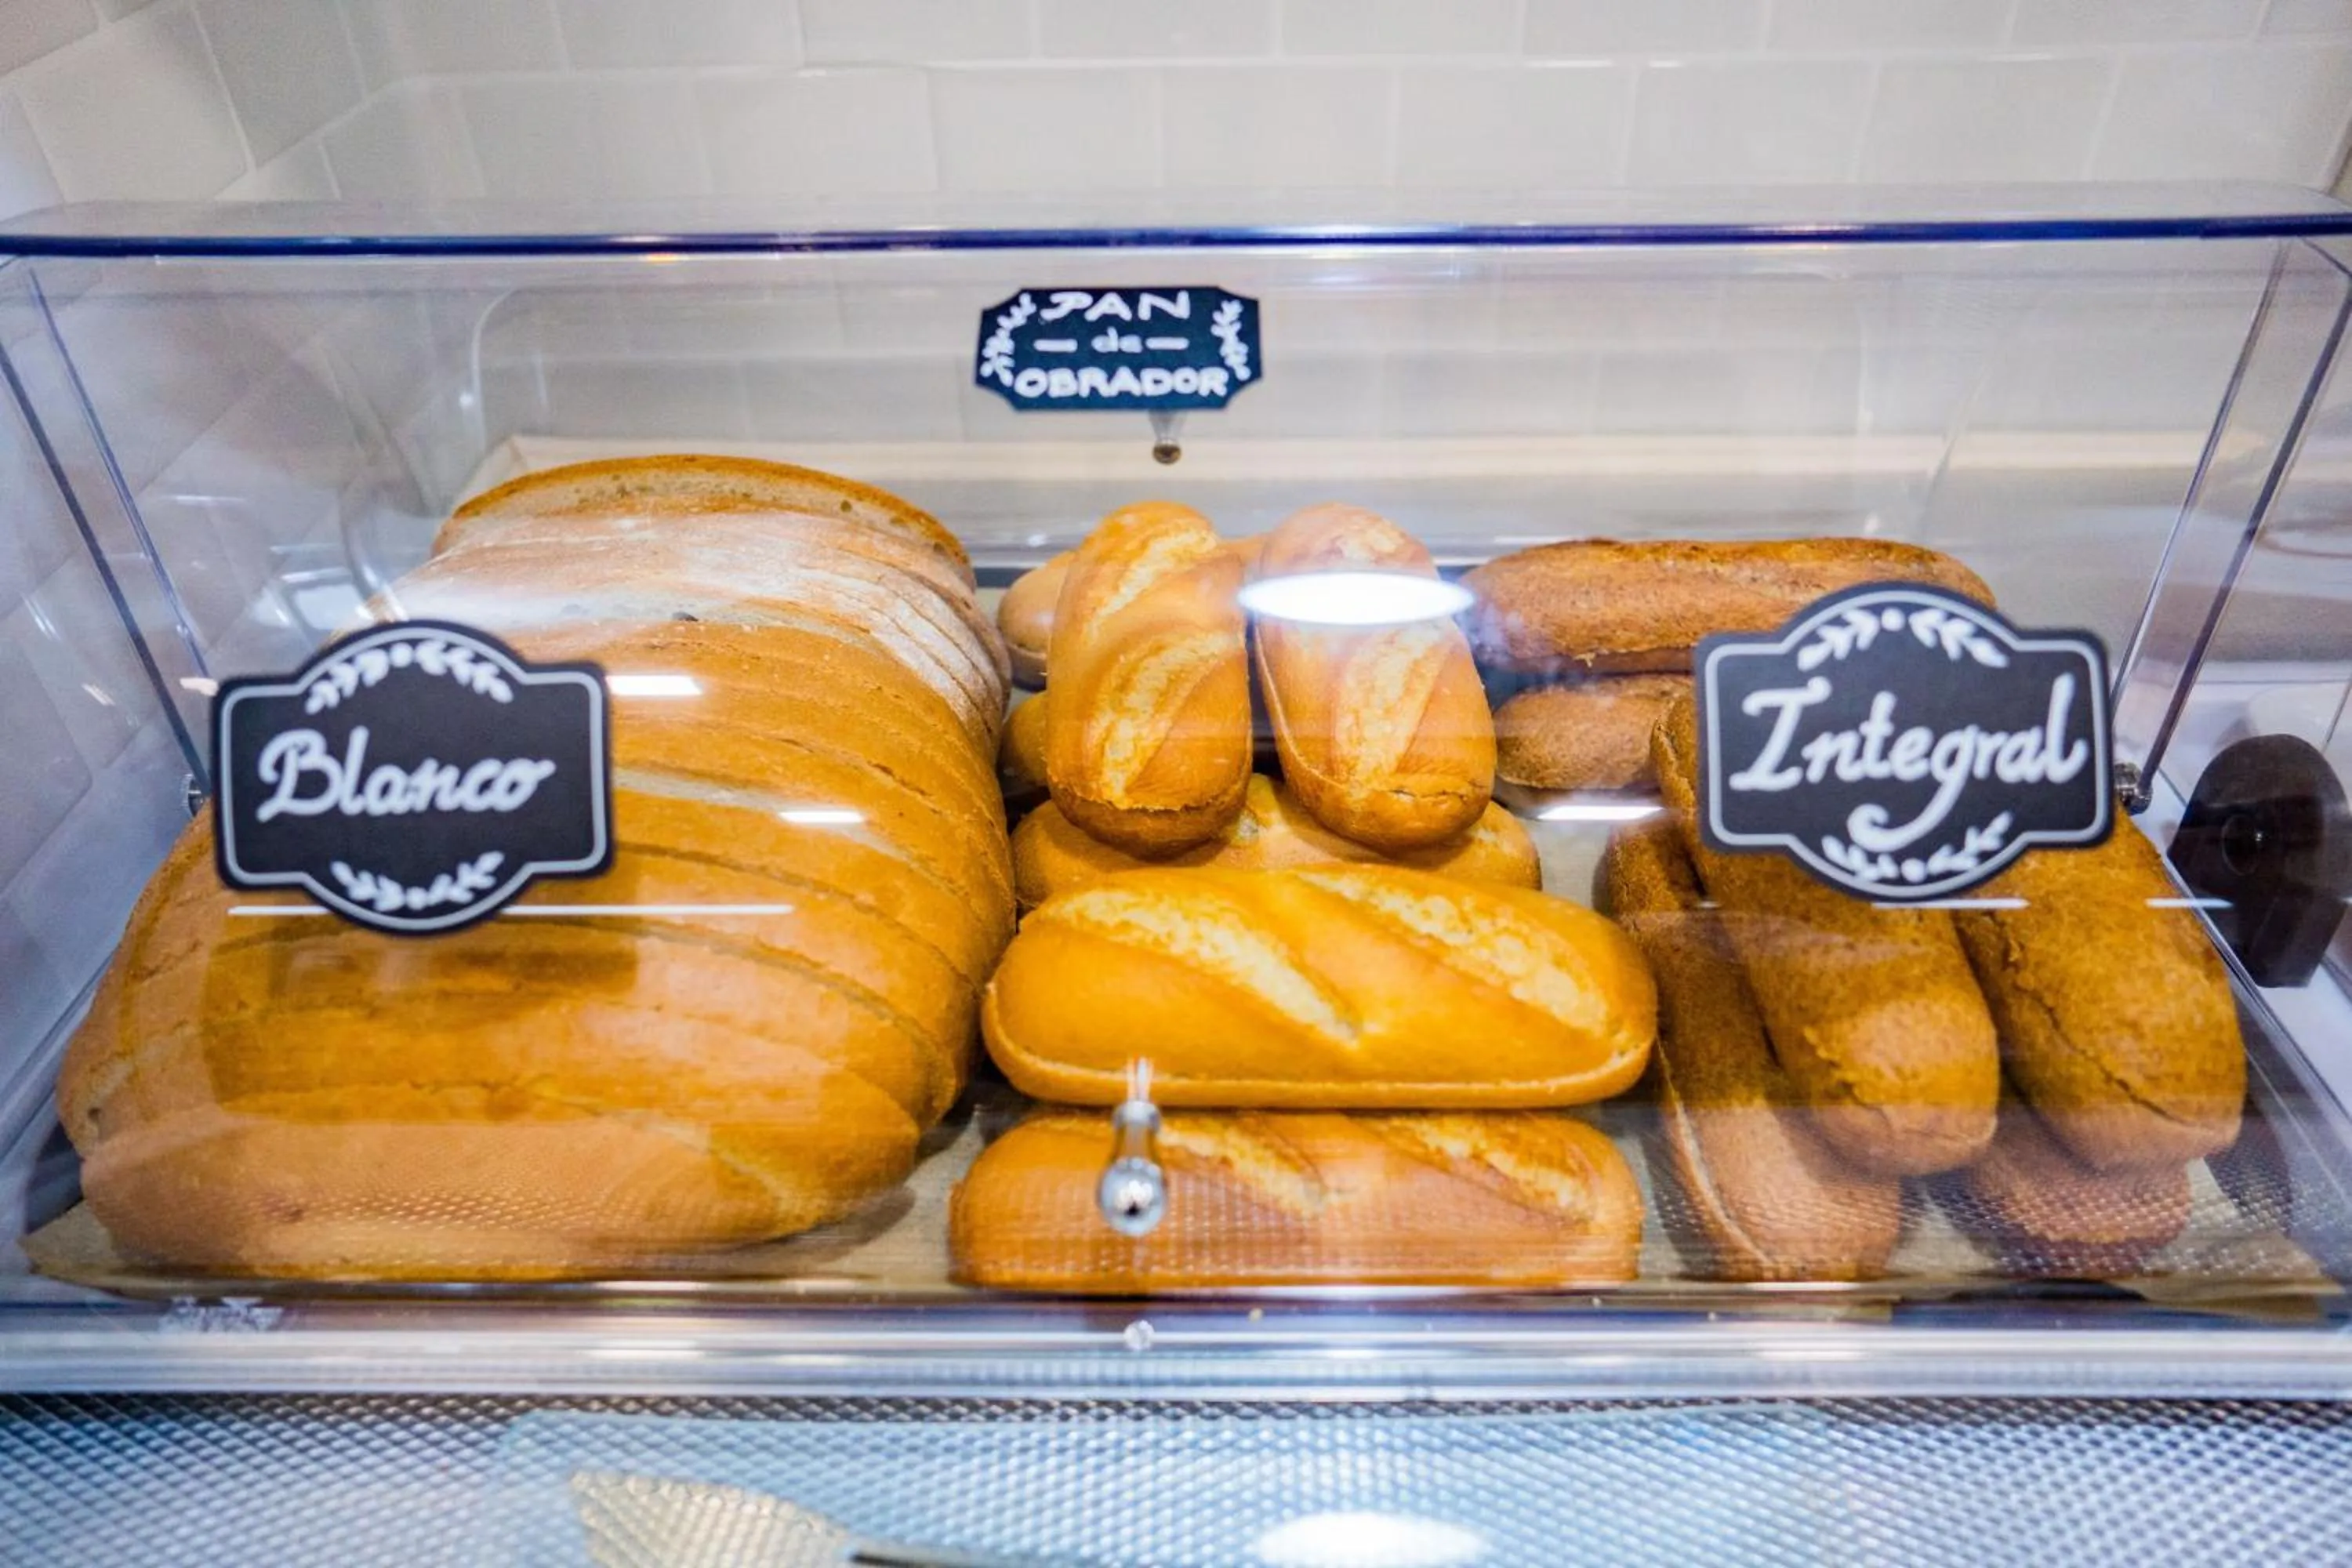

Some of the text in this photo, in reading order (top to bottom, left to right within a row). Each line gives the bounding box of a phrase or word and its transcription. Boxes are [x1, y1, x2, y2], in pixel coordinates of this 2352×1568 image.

[1040, 290, 1190, 321] PAN
[1091, 326, 1142, 353] de
[1014, 365, 1229, 398] OBRADOR
[256, 726, 556, 823] Blanco
[1730, 672, 2089, 853] Integral
